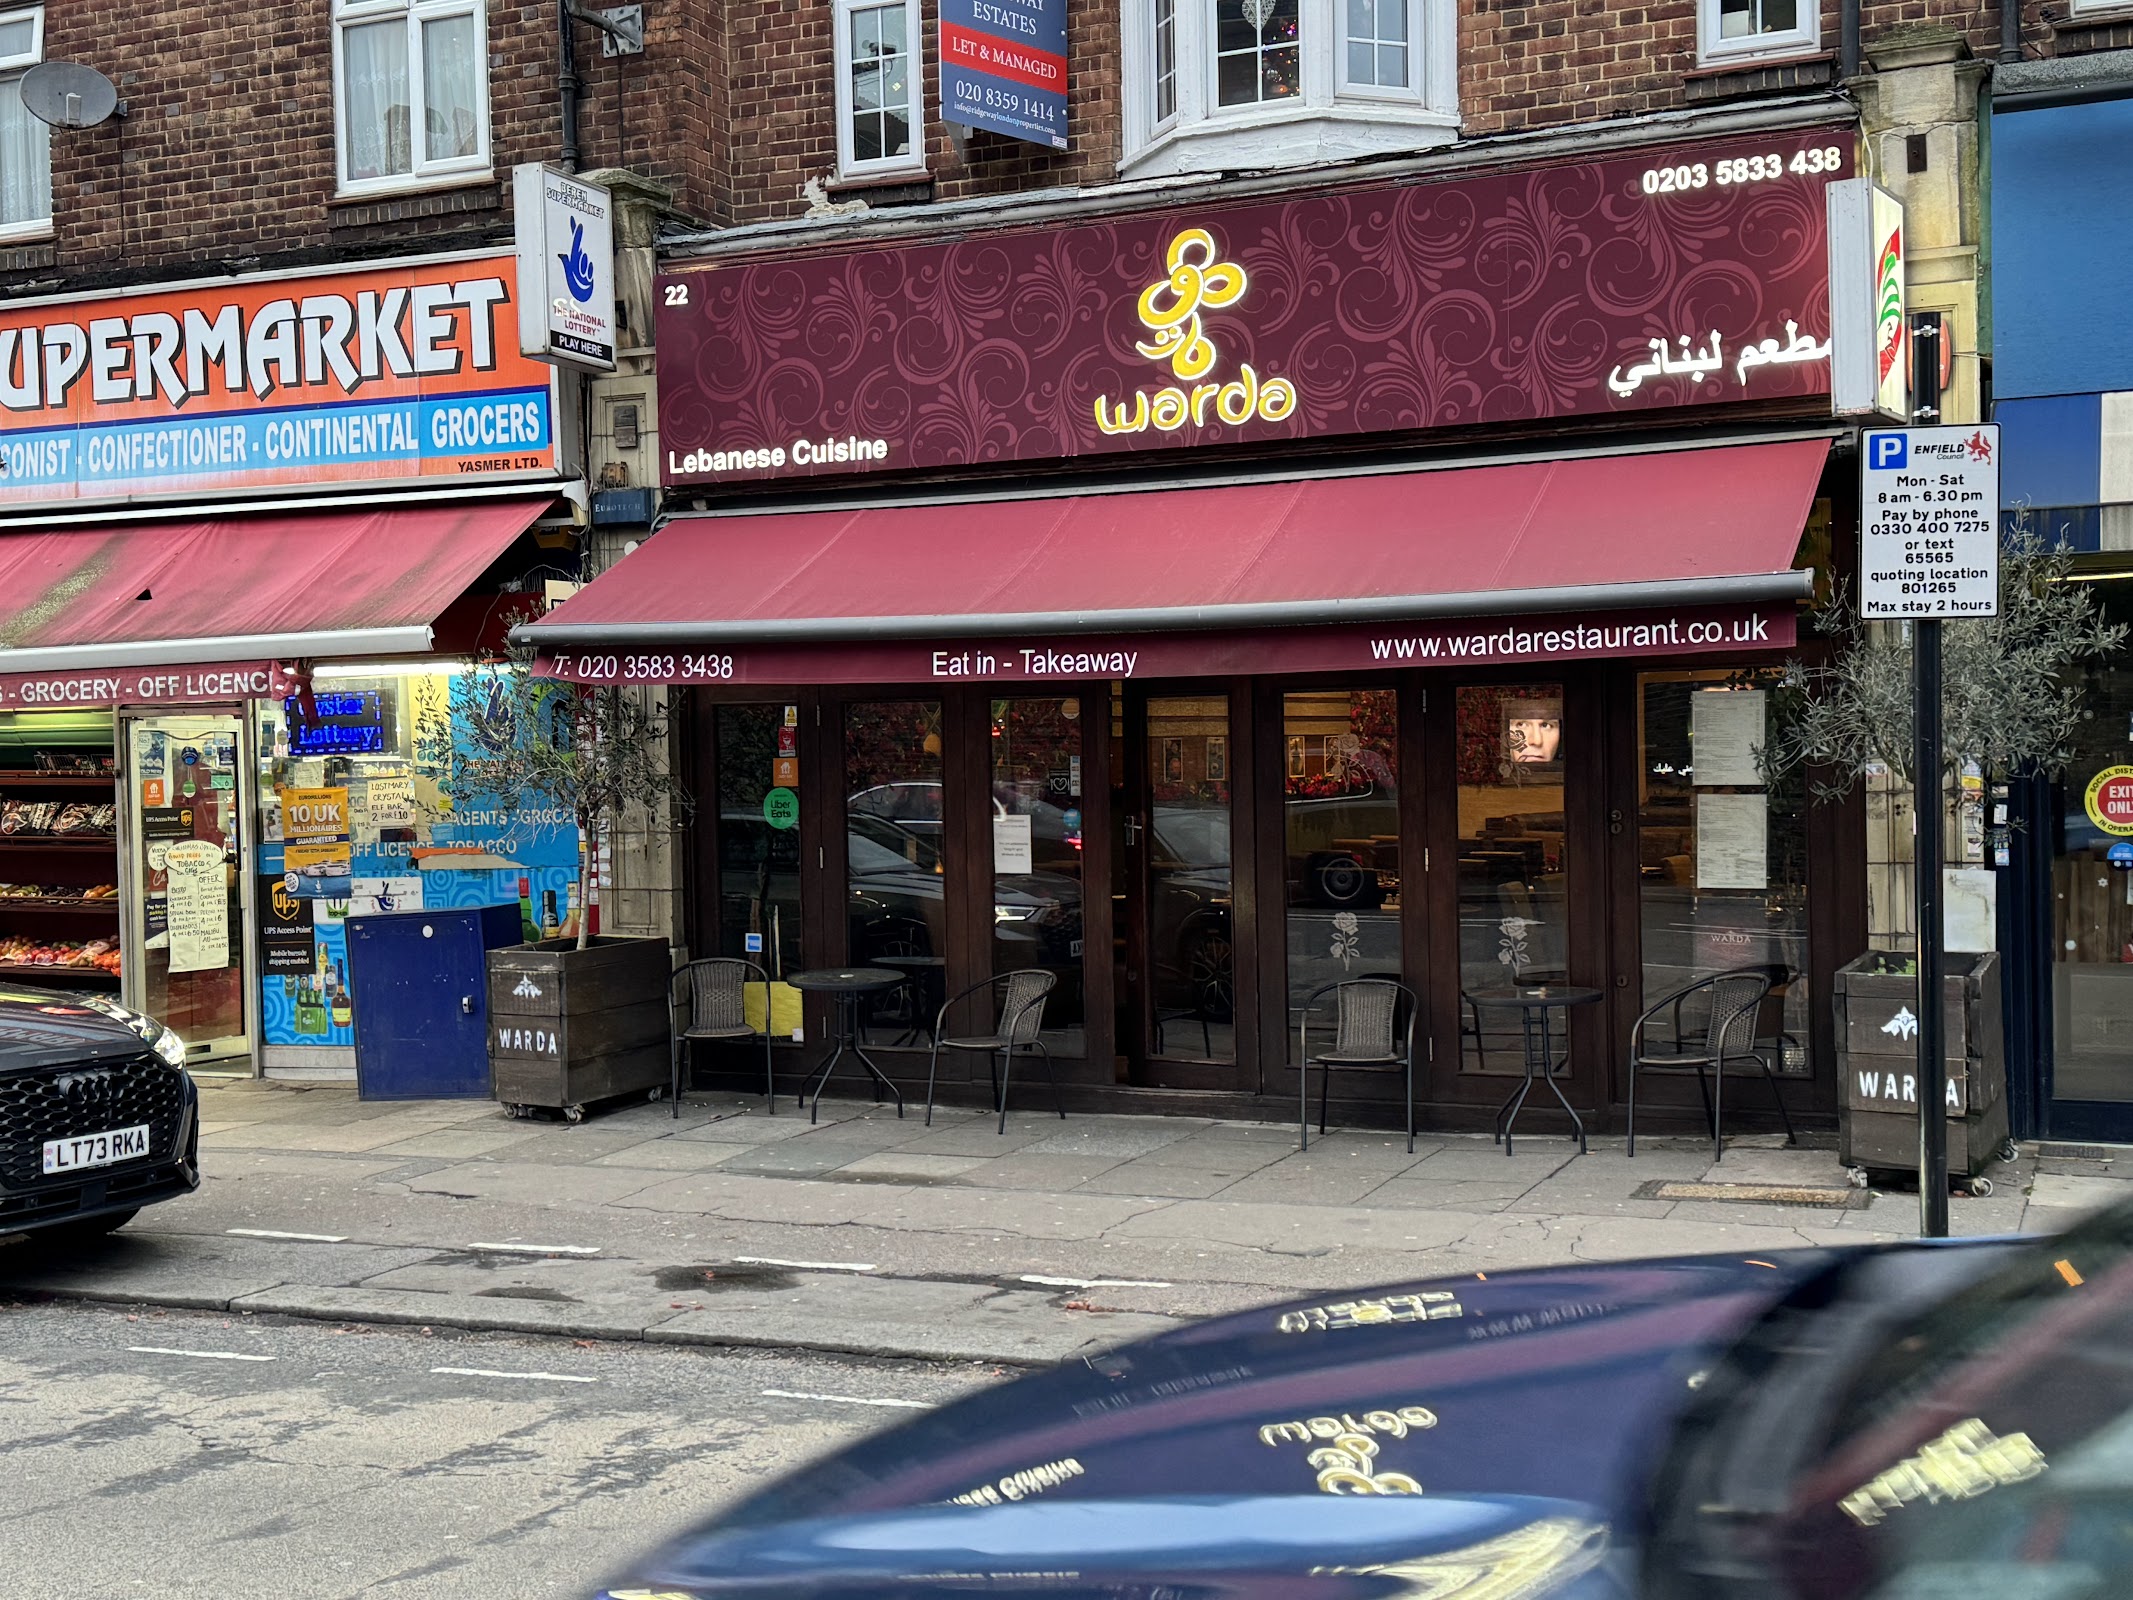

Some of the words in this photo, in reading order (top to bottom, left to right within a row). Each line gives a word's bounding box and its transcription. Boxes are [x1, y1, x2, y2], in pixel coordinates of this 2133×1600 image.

[973, 0, 1037, 36] ESTATES
[952, 36, 977, 56] LET
[979, 45, 990, 60] &
[993, 48, 1057, 79] MANAGED
[956, 80, 981, 102] 020
[986, 88, 1018, 111] 8359
[1024, 98, 1054, 122] 1414
[1642, 163, 1709, 195] 0203
[1715, 153, 1783, 185] 5833
[1789, 146, 1842, 175] 438
[560, 181, 588, 199] BEREN
[546, 187, 605, 220] SUPERMARKET
[664, 284, 689, 306] 22
[564, 319, 597, 336] LOTTERY
[569, 309, 607, 328] NATIONAL
[559, 335, 579, 351] PLAY
[581, 341, 603, 356] HERE
[1608, 328, 1723, 398] لبناني
[1094, 363, 1297, 435] warda
[88, 424, 247, 474] CONFECTIONER
[264, 411, 419, 461] CONTINENTAL
[431, 401, 539, 449] GROCERS
[669, 447, 786, 474] Lebanese
[792, 436, 888, 466] Cuisine
[1914, 443, 1965, 454] ENFIELD
[1937, 452, 1965, 460] Council
[458, 458, 510, 473] YASMER
[514, 457, 543, 471] LTD.
[1897, 475, 1927, 487] Mon
[1939, 474, 1964, 485] Sat
[1878, 492, 1887, 504] 8
[1891, 494, 1911, 503] am
[1923, 490, 1958, 502] 6.30
[1961, 491, 1983, 503] pm
[1882, 510, 1907, 522] Pay
[1912, 509, 1929, 521] by
[1934, 508, 1979, 521] phone
[1870, 523, 1912, 535] 0330
[1917, 522, 1949, 534] 400
[1955, 521, 1990, 533] 7275
[1905, 540, 1920, 550] or
[1925, 538, 1954, 549] text
[1905, 552, 1954, 564] 65565
[1870, 569, 1925, 582] quoting
[1930, 567, 1988, 579] location
[1901, 582, 1957, 594] 801265
[1867, 601, 1897, 612] Max
[1901, 601, 1931, 613] stay
[1936, 600, 1946, 610] 2
[1951, 599, 1992, 610] hours
[1371, 613, 1769, 659] www.wardarestaurant.co.uk
[554, 655, 571, 676] T:
[578, 655, 618, 678] 020
[623, 655, 675, 678] 3583
[681, 654, 733, 679] 3438
[932, 651, 970, 676] Eat
[976, 650, 996, 675] in
[1019, 648, 1138, 678] Takeaway
[20, 677, 121, 703] GROCERY
[138, 675, 180, 698] OFF
[186, 670, 274, 696] LICENC
[299, 697, 365, 718] yster
[299, 724, 375, 747] Lottery
[2090, 771, 2114, 793] SOCIAL
[289, 804, 309, 823] 10
[314, 804, 341, 822] UK
[372, 813, 378, 821] 2
[771, 810, 791, 818] Eats
[2107, 801, 2133, 814] ONL
[452, 810, 508, 826] AGENTS
[290, 825, 343, 833] MILLIONAIRES
[296, 836, 337, 845] GUARANTEED
[264, 927, 276, 935] UPS
[277, 927, 295, 935] Access
[296, 926, 312, 934] Point
[1711, 934, 1752, 943] WARDA
[499, 1028, 557, 1054] WARDA
[1859, 1071, 1959, 1107] WARA
[57, 1137, 107, 1167] LT73
[112, 1130, 145, 1157] RKA
